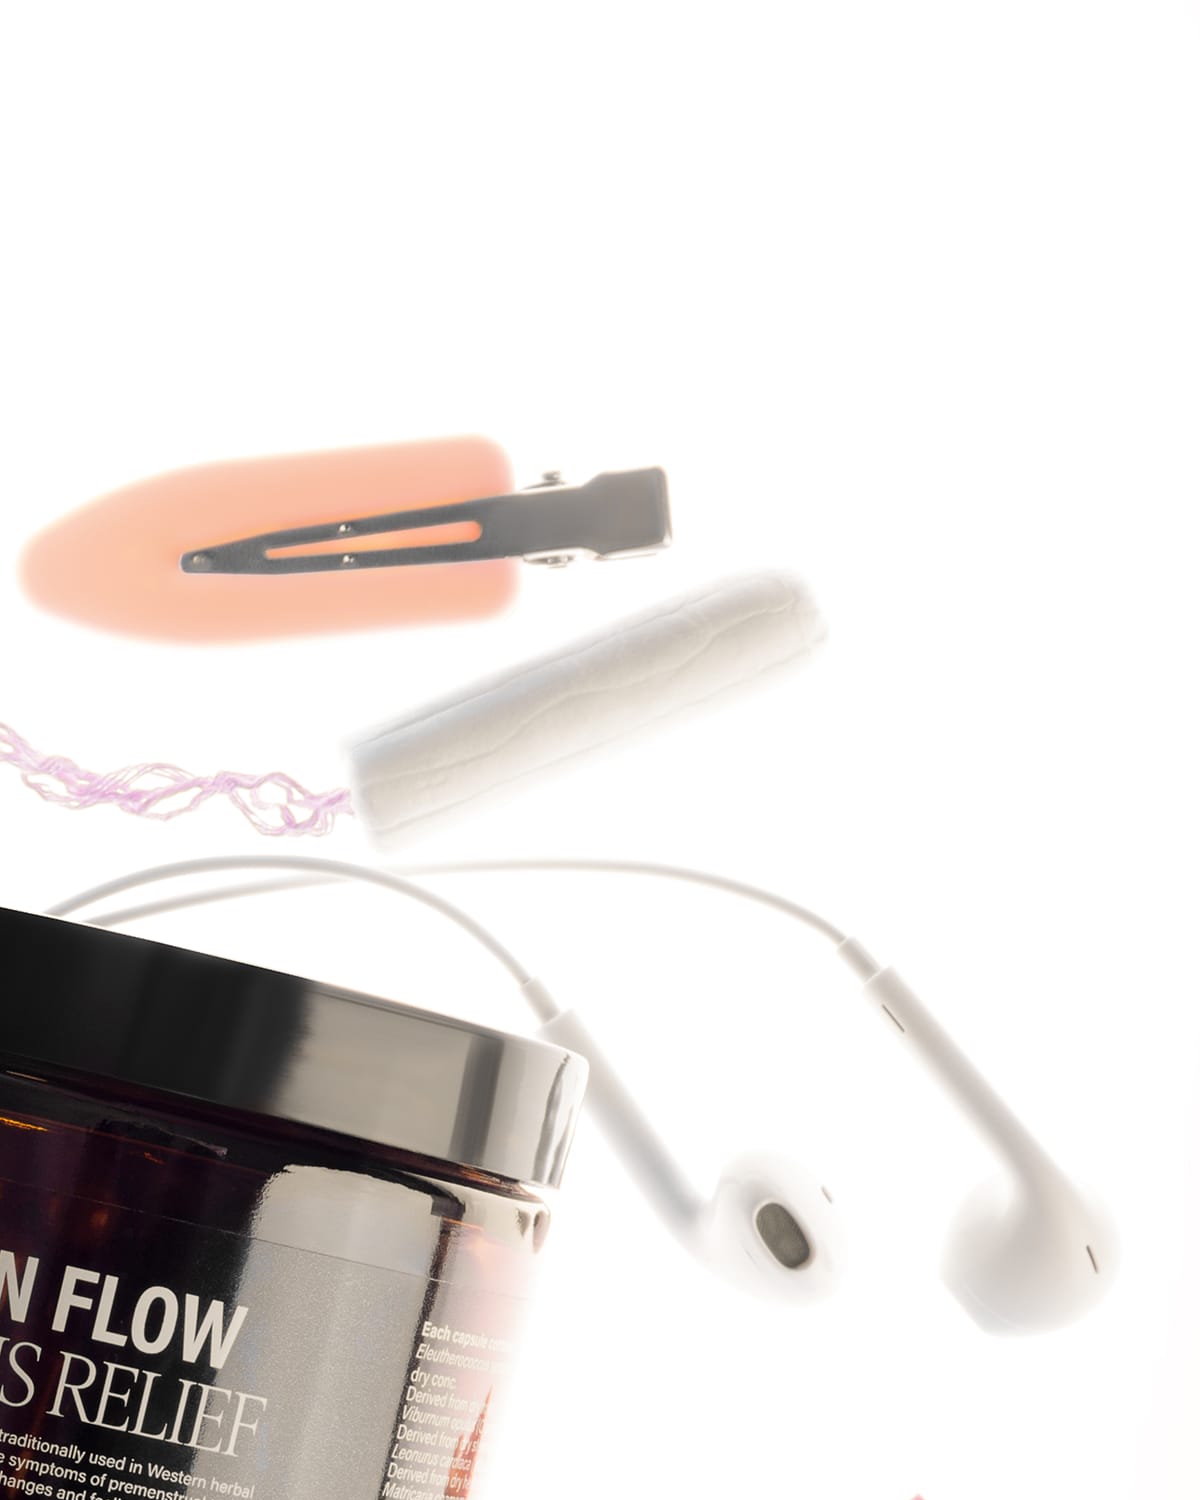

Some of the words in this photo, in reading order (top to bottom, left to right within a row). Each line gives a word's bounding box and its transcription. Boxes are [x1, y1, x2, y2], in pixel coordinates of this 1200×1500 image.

[51, 1265, 248, 1370] FLOW
[421, 1321, 450, 1341] Each
[411, 1367, 431, 1388] dry
[45, 1351, 267, 1457] RELIEF
[406, 1385, 450, 1409] Derived
[402, 1405, 450, 1426] Viburnum
[397, 1424, 440, 1446] Derived
[391, 1443, 439, 1464] Leonurus
[8, 1455, 87, 1484] symptoms
[89, 1473, 107, 1487] of
[89, 1452, 126, 1471] used
[129, 1458, 143, 1475] in
[147, 1462, 207, 1489] Western
[210, 1477, 255, 1499] herbal
[387, 1462, 429, 1484] Derived
[430, 1470, 449, 1486] from
